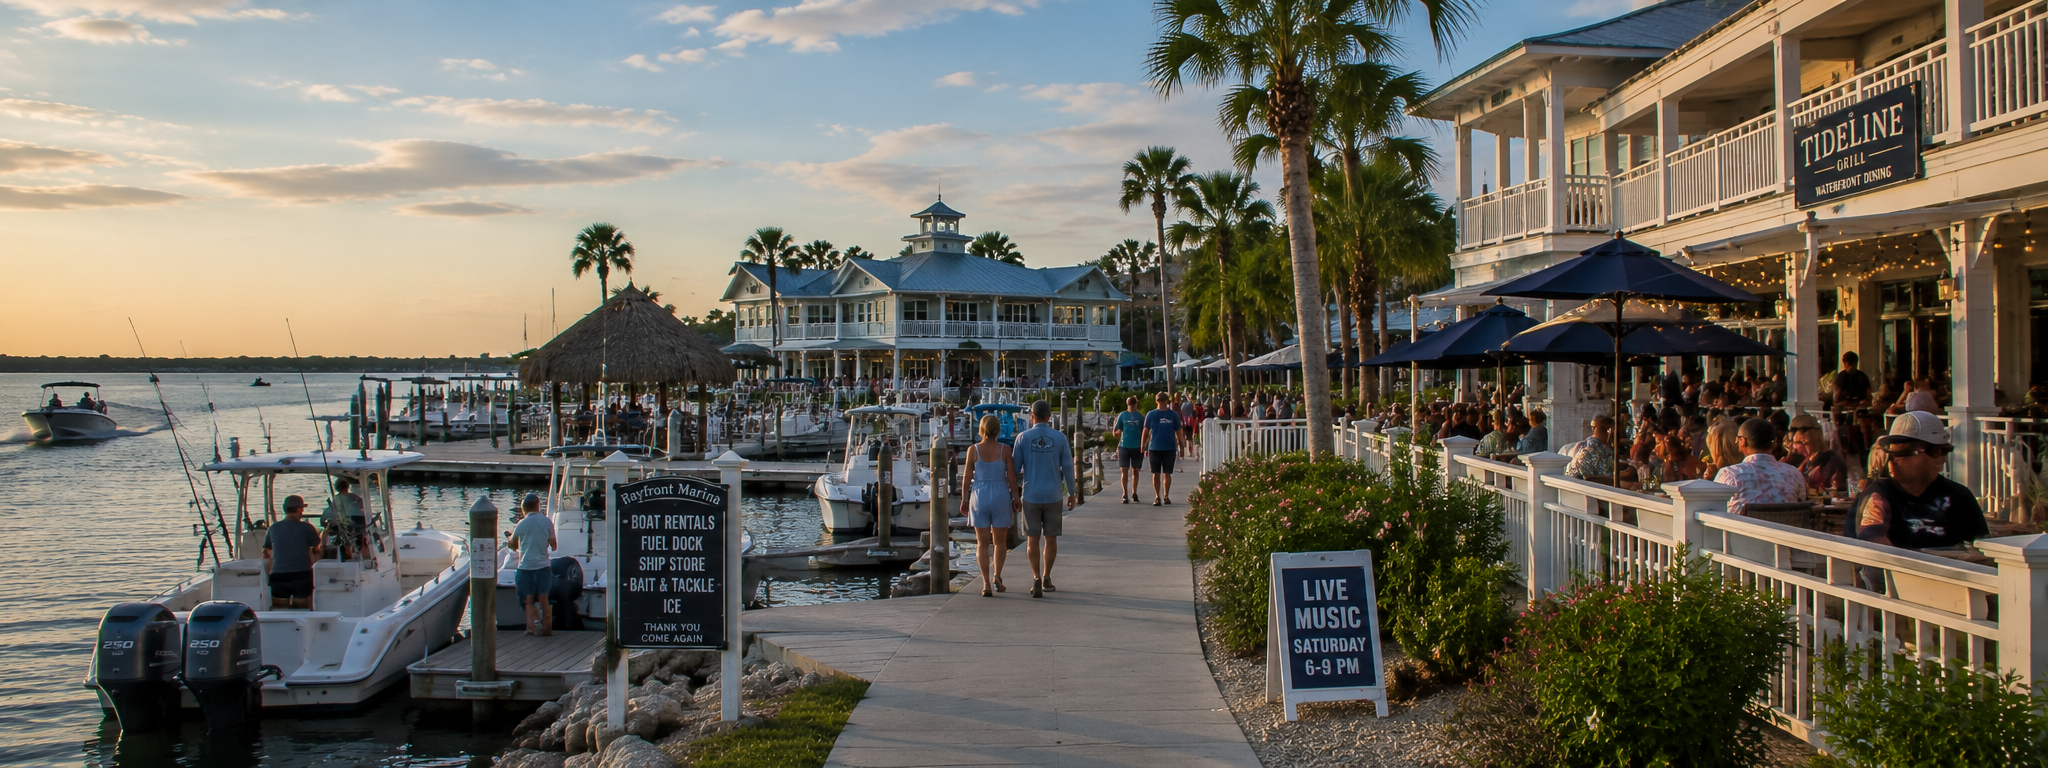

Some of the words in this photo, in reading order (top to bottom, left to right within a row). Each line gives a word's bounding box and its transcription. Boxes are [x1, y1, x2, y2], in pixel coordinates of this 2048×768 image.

[1801, 102, 1904, 168] TIDELINE
[1815, 174, 1861, 197] WATERFRONT
[1863, 165, 1892, 184] DINING
[678, 483, 721, 505] Marina
[631, 515, 661, 529] BOAT
[664, 515, 715, 530] RENTALS
[641, 536, 668, 550] FUEL
[672, 536, 704, 551] DOCK
[639, 556, 666, 571] SHIP
[669, 557, 706, 572] STORE
[630, 577, 656, 592] BAIT
[659, 577, 668, 592] &
[671, 578, 715, 593] TACKLE
[1302, 578, 1349, 601] LIVE
[663, 599, 681, 613] ICE
[1294, 606, 1362, 630] MUSIC
[644, 623, 677, 632] THANK
[680, 623, 701, 632] YOU
[103, 640, 134, 650] 250
[190, 639, 220, 649] 250
[641, 634, 669, 643] COME
[673, 634, 703, 643] AGAIN
[1294, 637, 1366, 654] SATURDAY
[1305, 658, 1331, 676] 6-9
[1336, 658, 1360, 675] PM
